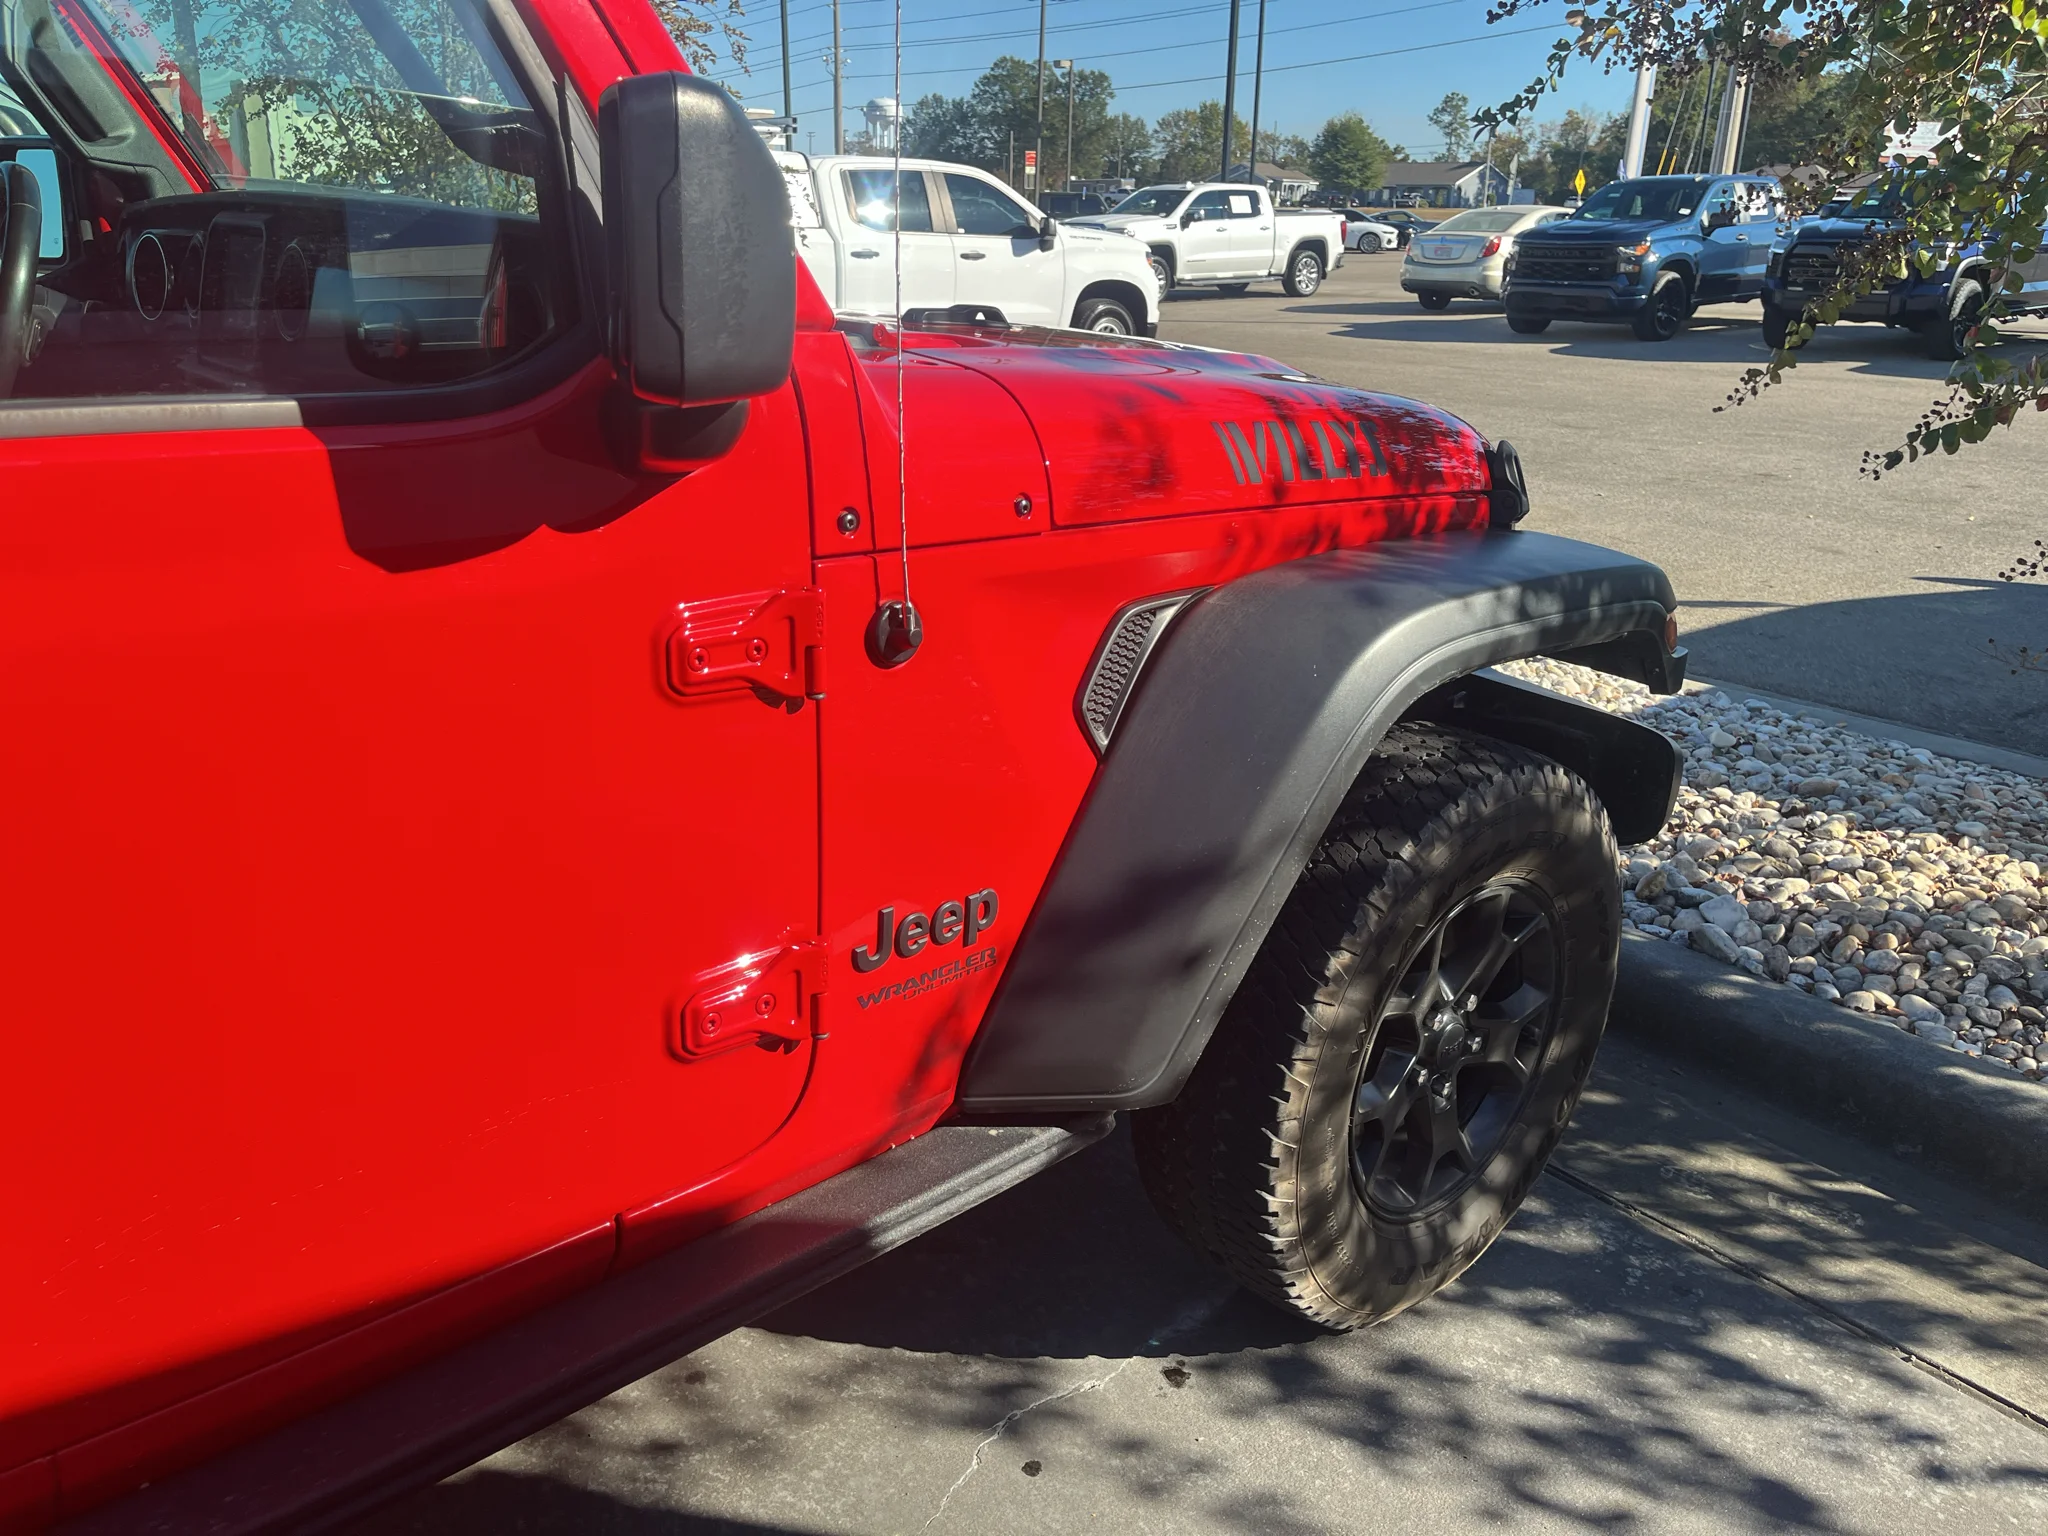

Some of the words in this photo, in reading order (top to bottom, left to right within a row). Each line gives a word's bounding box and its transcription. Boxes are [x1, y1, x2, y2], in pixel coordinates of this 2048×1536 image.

[1210, 420, 1389, 485] WILLYS
[851, 888, 999, 974] Jeep
[857, 946, 997, 1009] WRANGLER
[903, 959, 997, 1001] UNLIMITED
